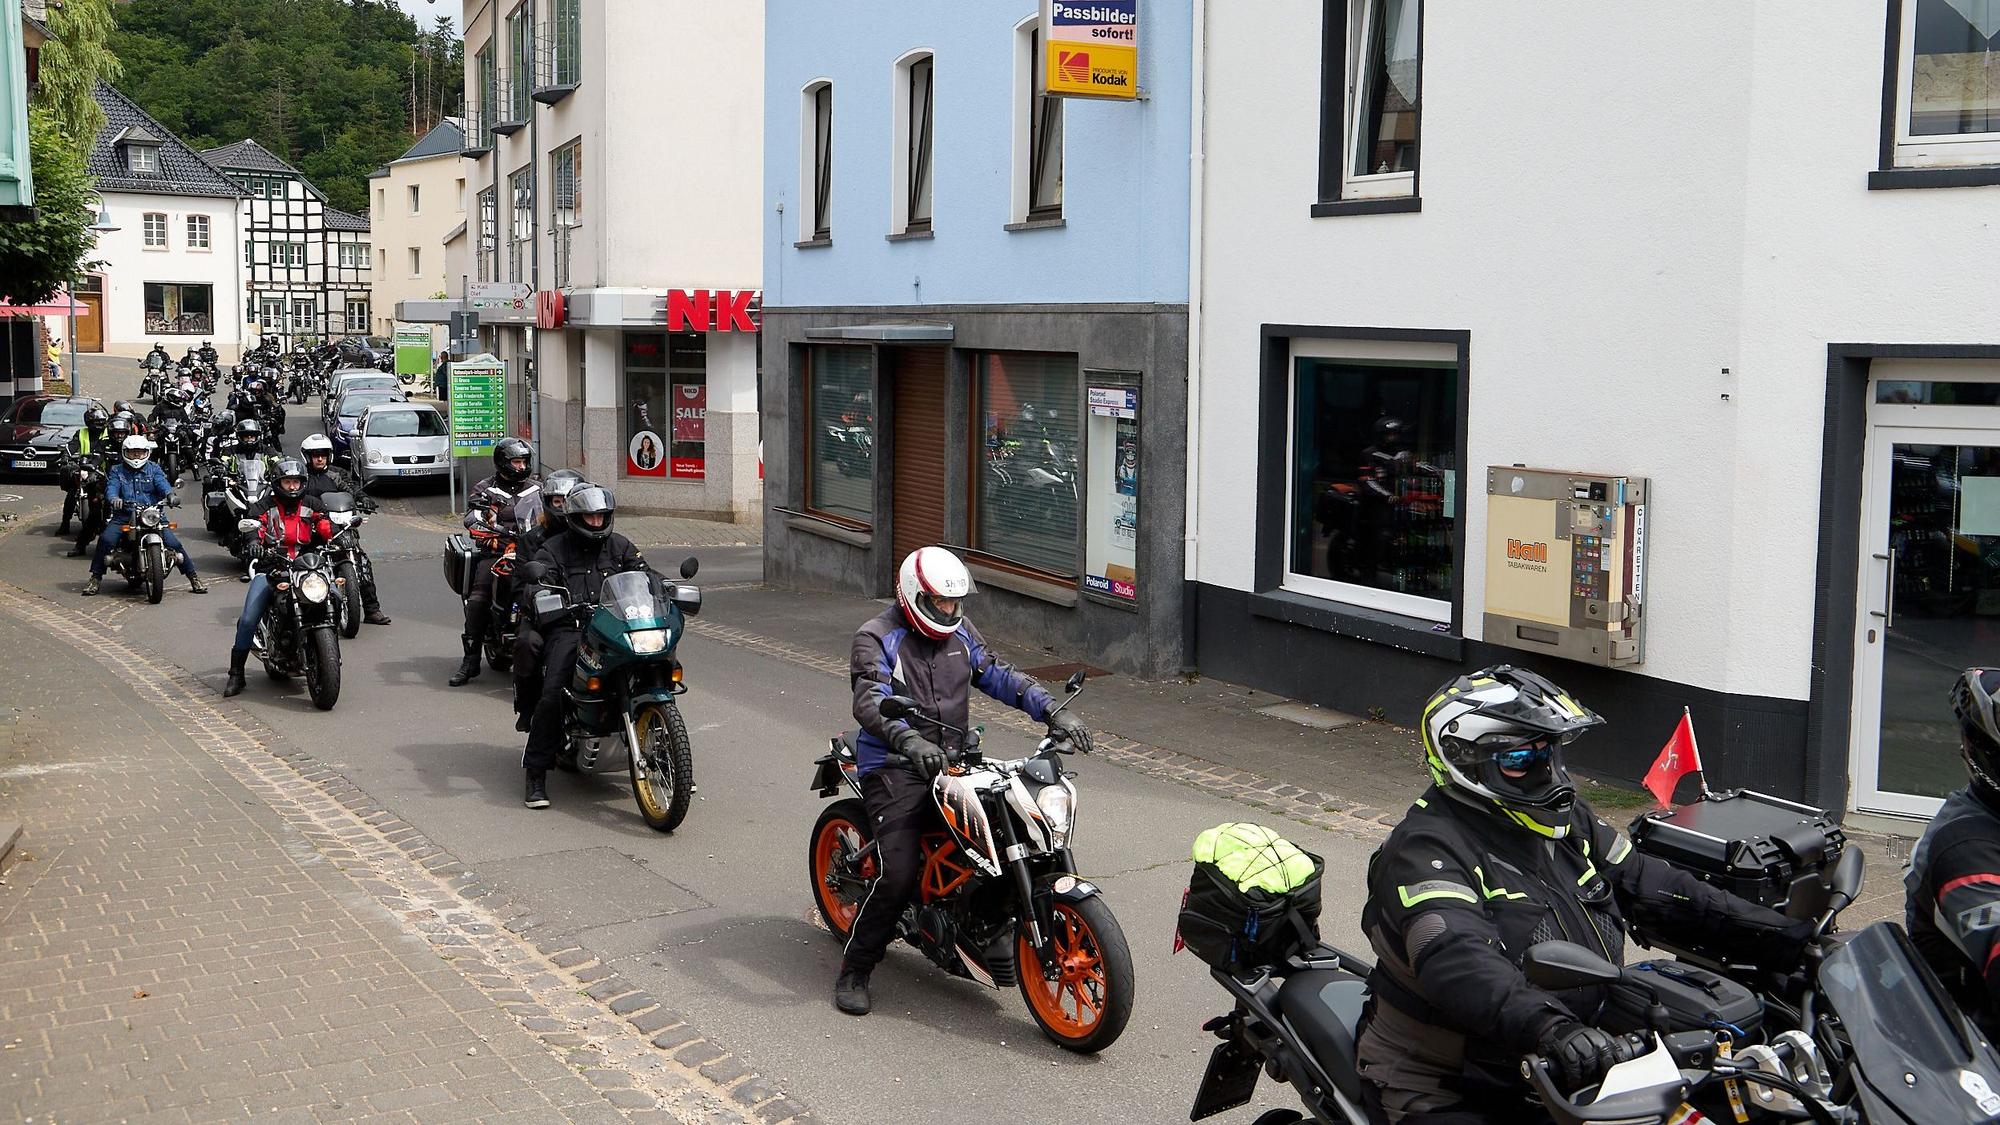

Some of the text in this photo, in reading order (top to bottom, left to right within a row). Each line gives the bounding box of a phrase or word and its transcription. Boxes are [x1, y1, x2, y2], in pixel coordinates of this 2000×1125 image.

[1053, 3, 1135, 24] Passbilder
[1092, 27, 1133, 40] sofort!
[1092, 73, 1127, 86] Kodak
[668, 289, 763, 332] NK
[1090, 389, 1106, 397] Polaroid
[1089, 396, 1102, 404] Studio
[1103, 398, 1119, 406] Express
[676, 407, 706, 419] SALE
[1507, 538, 1548, 563] Hall
[1634, 508, 1643, 601] CIGARETTEN
[1507, 561, 1547, 573] TABAKWAREN
[1085, 576, 1134, 597] Polaroid Studio
